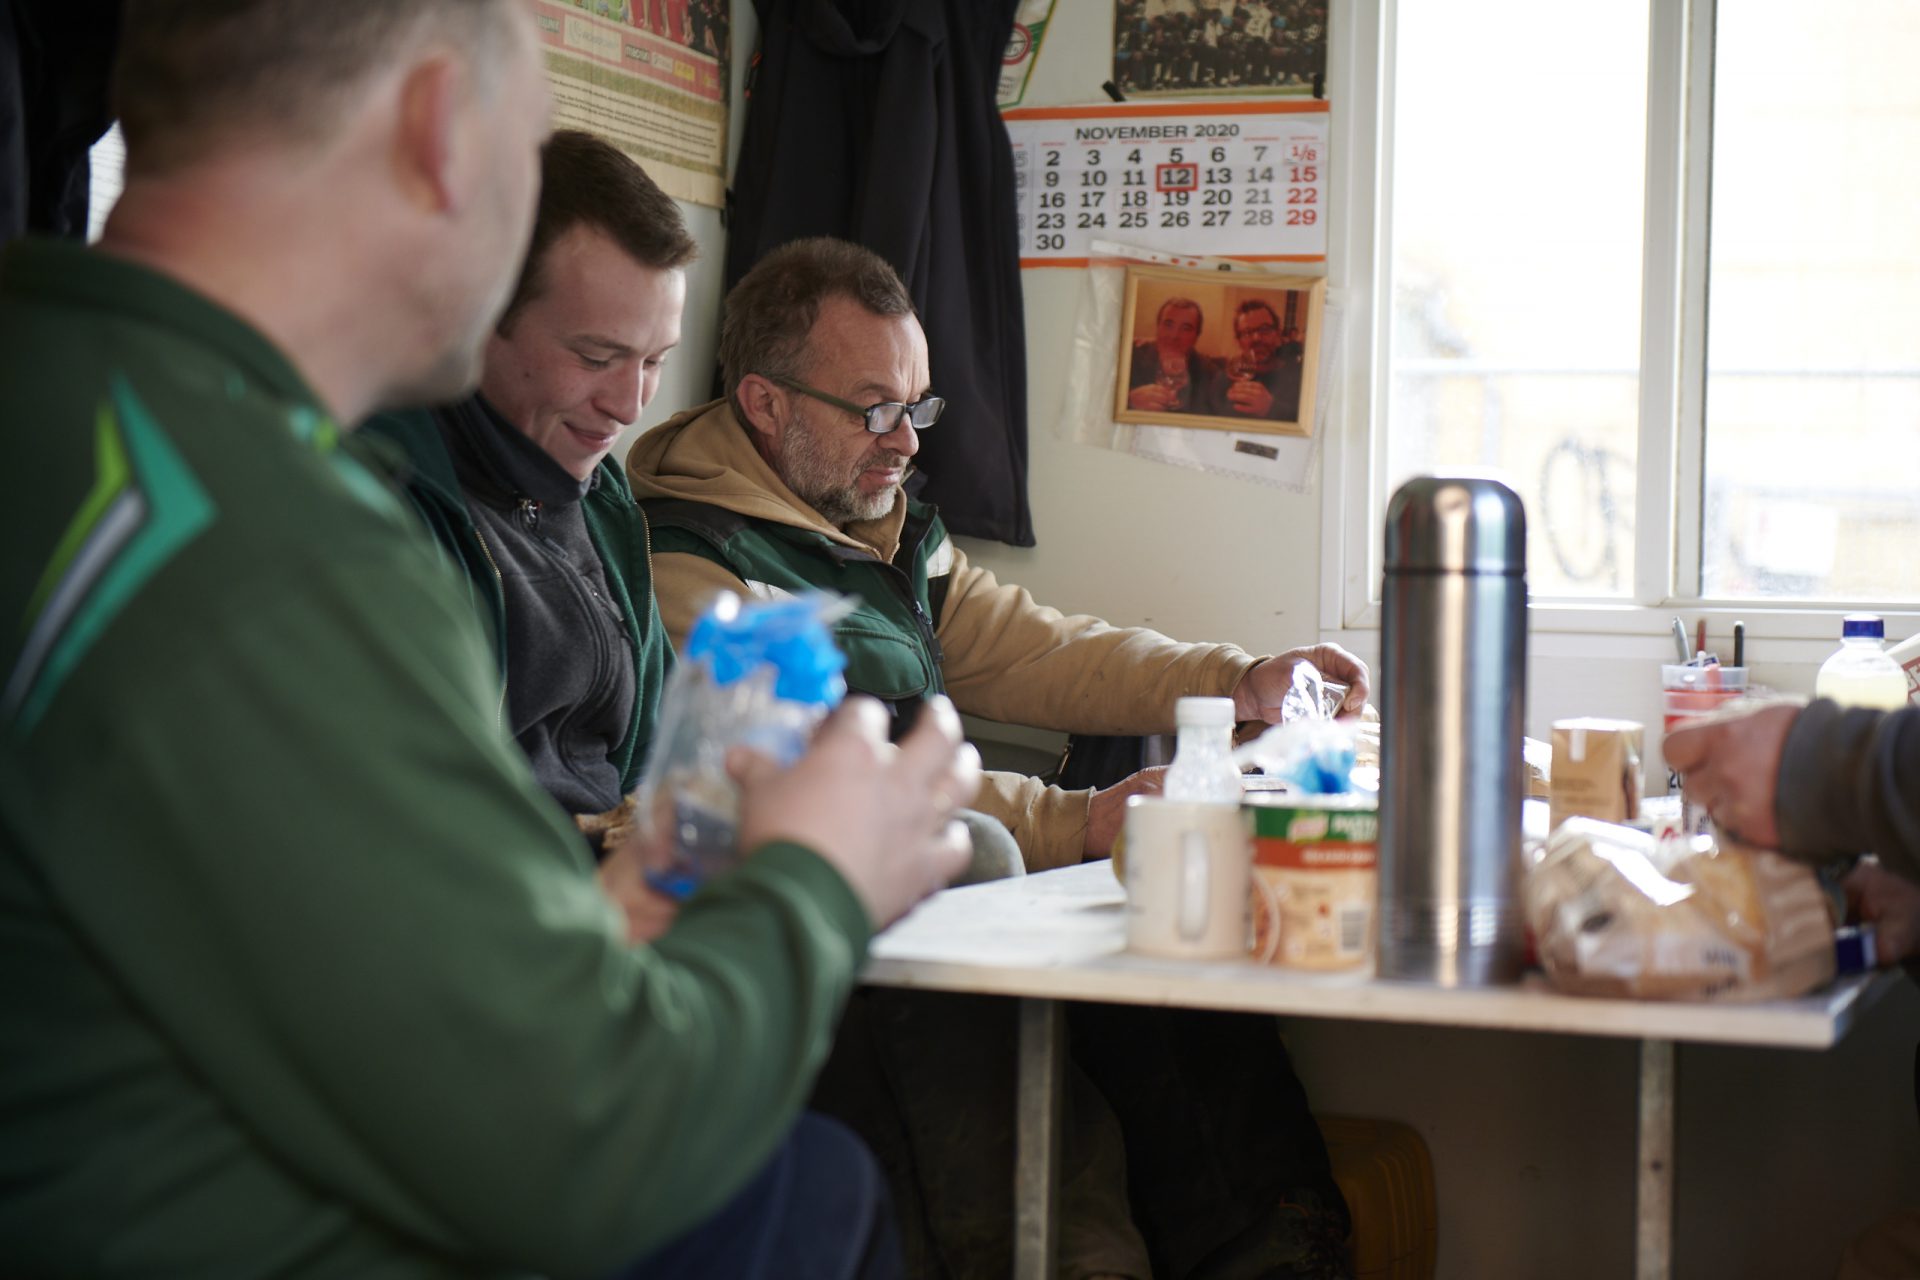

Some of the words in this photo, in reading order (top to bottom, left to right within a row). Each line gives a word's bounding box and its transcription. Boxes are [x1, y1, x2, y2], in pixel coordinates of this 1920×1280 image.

[1075, 125, 1188, 140] NOVEMBER
[1194, 124, 1240, 137] 2020
[1046, 150, 1060, 166] 2
[1087, 149, 1101, 165] 3
[1127, 148, 1141, 164] 4
[1169, 147, 1183, 164] 5
[1211, 146, 1226, 163] 6
[1253, 146, 1268, 162] 7
[1045, 171, 1059, 187] 9
[1080, 170, 1107, 186] 10
[1122, 169, 1146, 186] 11
[1163, 168, 1190, 185] 12
[1205, 167, 1232, 184] 13
[1246, 167, 1274, 183] 14
[1289, 166, 1317, 183] 15
[1040, 192, 1066, 208] 16
[1080, 191, 1105, 207] 17
[1121, 190, 1147, 207] 18
[1163, 190, 1190, 206] 19
[1203, 189, 1232, 205] 20
[1244, 188, 1273, 204] 21
[1286, 187, 1317, 204] 22
[1036, 213, 1066, 229] 23
[1077, 212, 1106, 229] 24
[1119, 212, 1148, 228] 25
[1161, 211, 1190, 227] 26
[1202, 210, 1231, 226] 27
[1243, 209, 1274, 226] 28
[1286, 209, 1317, 226] 29
[1036, 234, 1065, 250] 30
